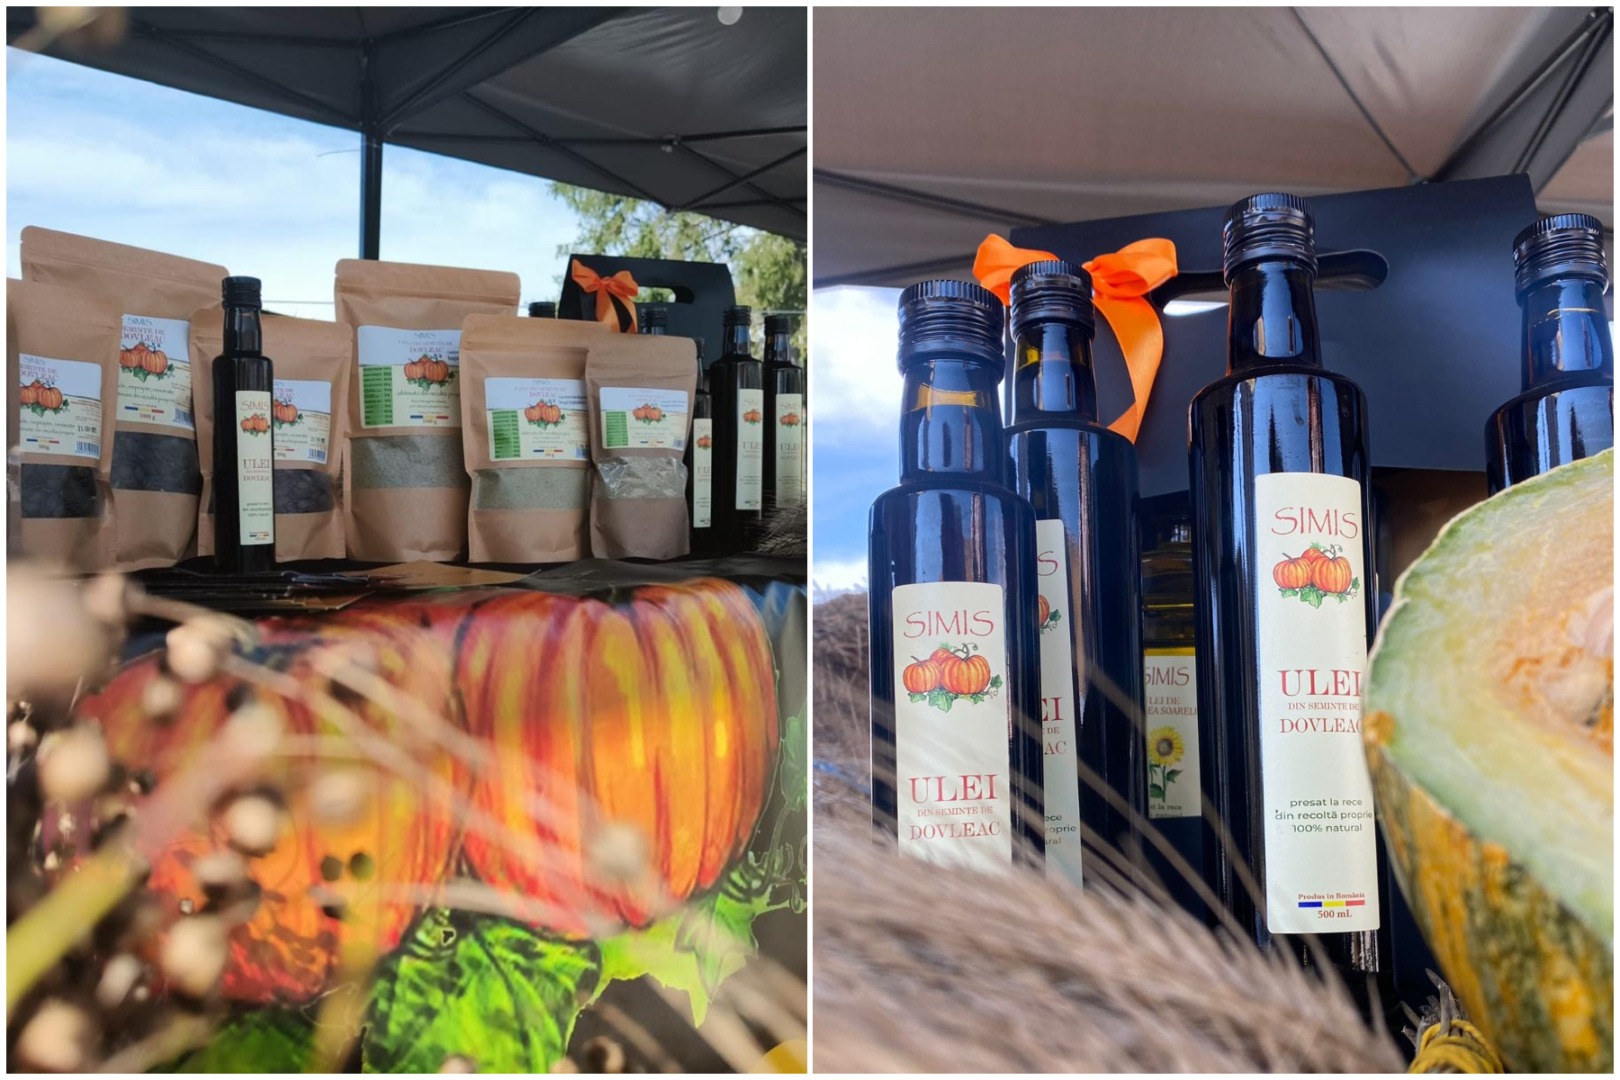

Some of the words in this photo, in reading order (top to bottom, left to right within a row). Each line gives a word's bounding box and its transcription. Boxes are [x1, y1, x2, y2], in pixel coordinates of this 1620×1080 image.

[241, 401, 270, 411] SIMIS
[243, 459, 270, 469] ULEI
[1270, 506, 1358, 539] SIMIS
[903, 610, 994, 639] SIMIS
[1277, 669, 1361, 698] ULEI
[1146, 696, 1165, 705] LEI
[1166, 696, 1180, 705] DE
[1288, 702, 1306, 711] DIN
[1307, 702, 1348, 712] SEMINTE
[1349, 703, 1360, 712] DE
[908, 773, 998, 804] ULEI
[1290, 799, 1327, 808] presat
[1330, 798, 1339, 806] la
[917, 809, 931, 817] DIN
[932, 807, 978, 816] SEMINTE
[980, 806, 993, 814] DE
[1275, 811, 1294, 820] din
[1297, 811, 1337, 819] recoltă
[1340, 810, 1372, 820] proprie
[910, 820, 1000, 841] DOVLEAC
[1292, 824, 1323, 833] 100%
[1325, 824, 1362, 832] natural
[1318, 910, 1335, 919] 500
[1337, 909, 1352, 918] mL
